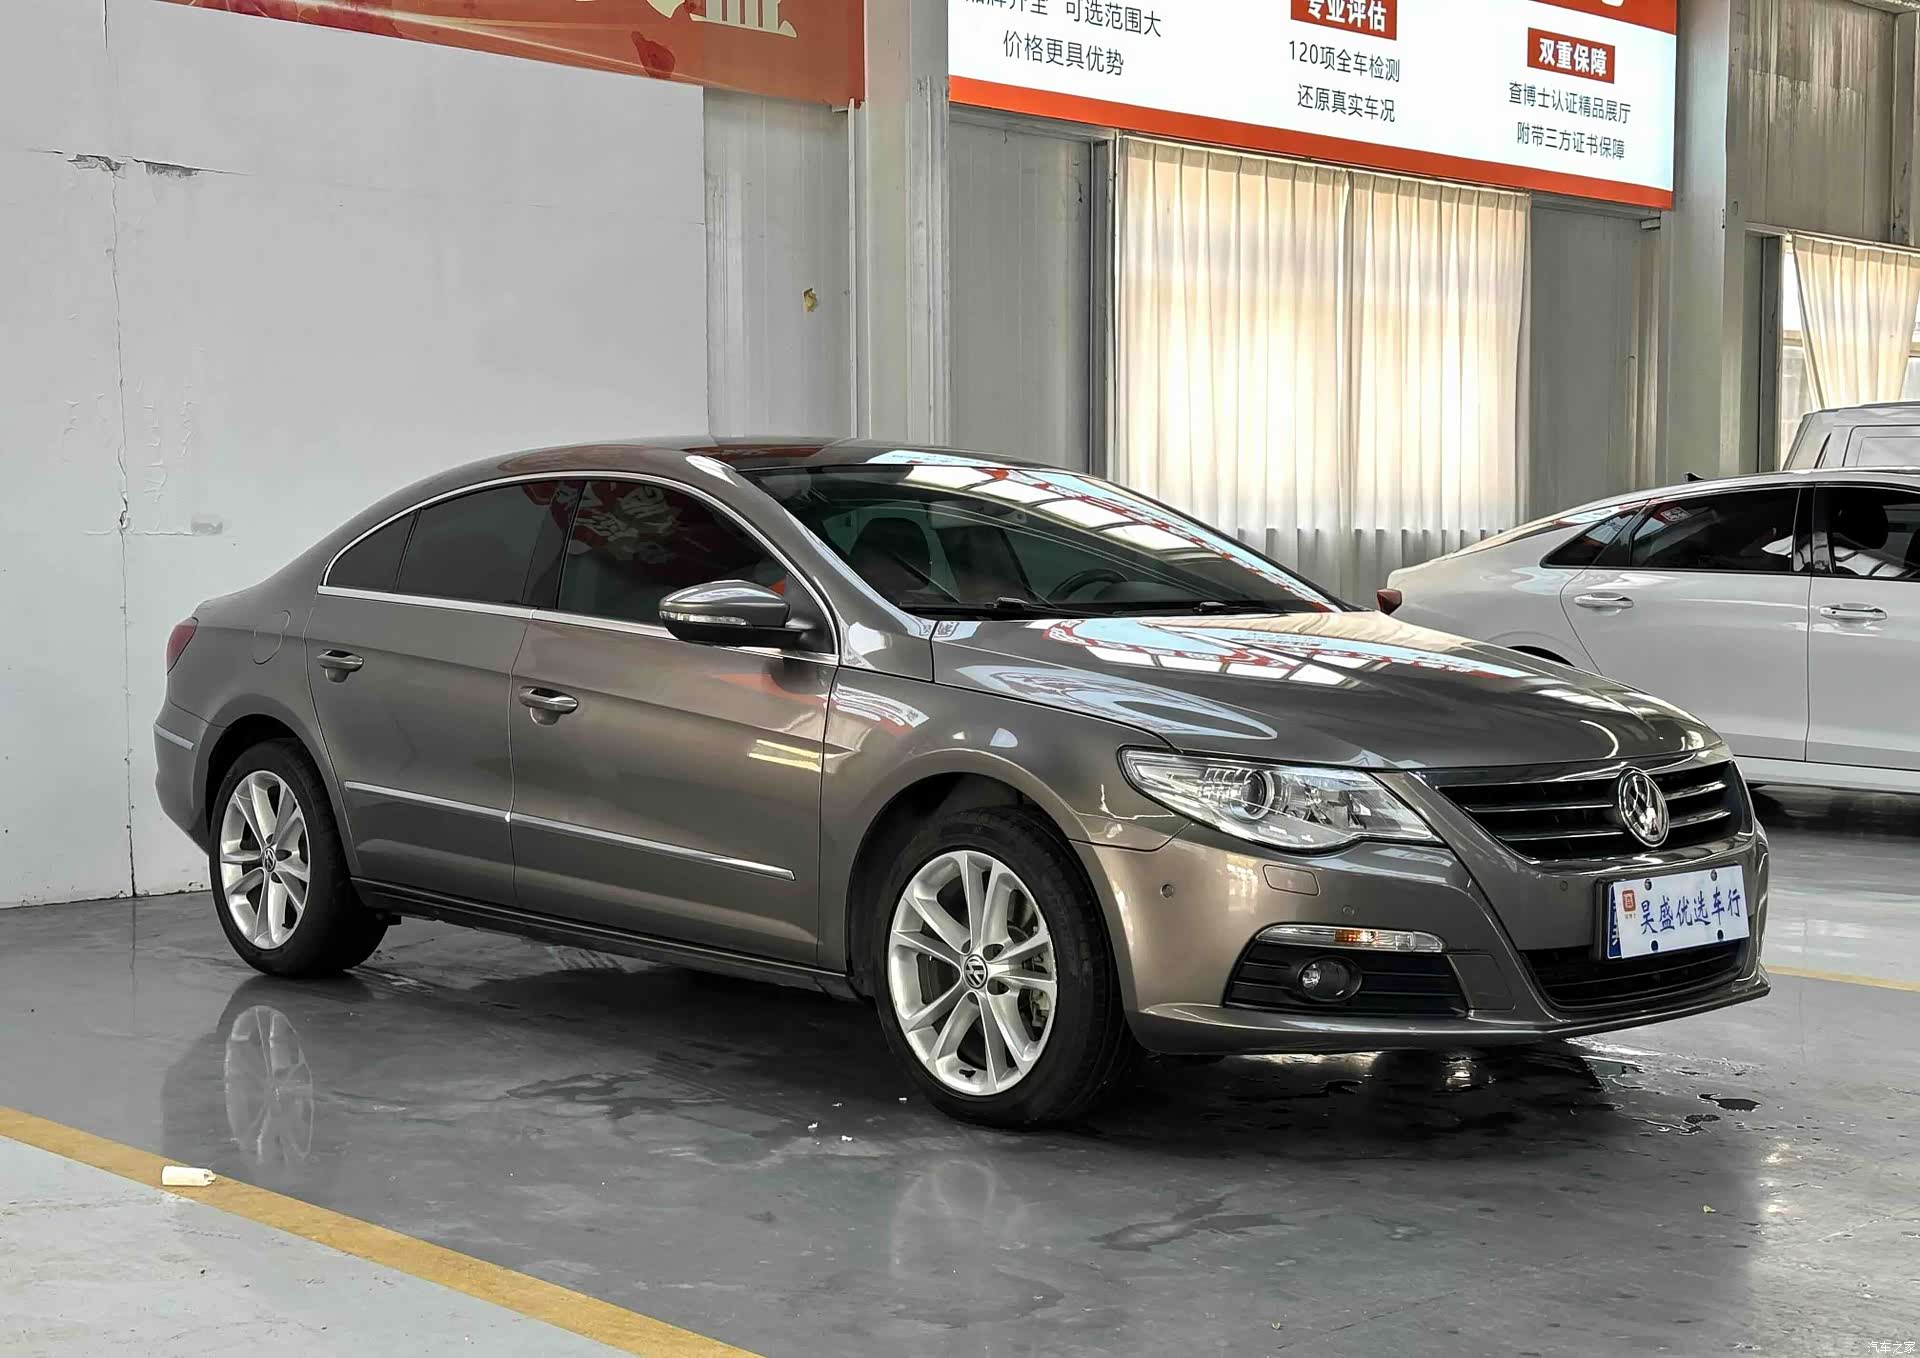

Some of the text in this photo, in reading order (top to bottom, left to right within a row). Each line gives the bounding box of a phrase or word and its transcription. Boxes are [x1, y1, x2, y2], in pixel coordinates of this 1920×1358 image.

[1066, 0, 1161, 37] 可选范围大
[1003, 30, 1124, 76] 价格更具优势
[1289, 40, 1400, 82] 120项全车检测
[1538, 37, 1608, 77] 双重保障
[1297, 83, 1395, 122] 还原真实车况
[1509, 81, 1631, 124] 查博士认证精品展厅
[1517, 121, 1625, 160] 附带三方证书保障
